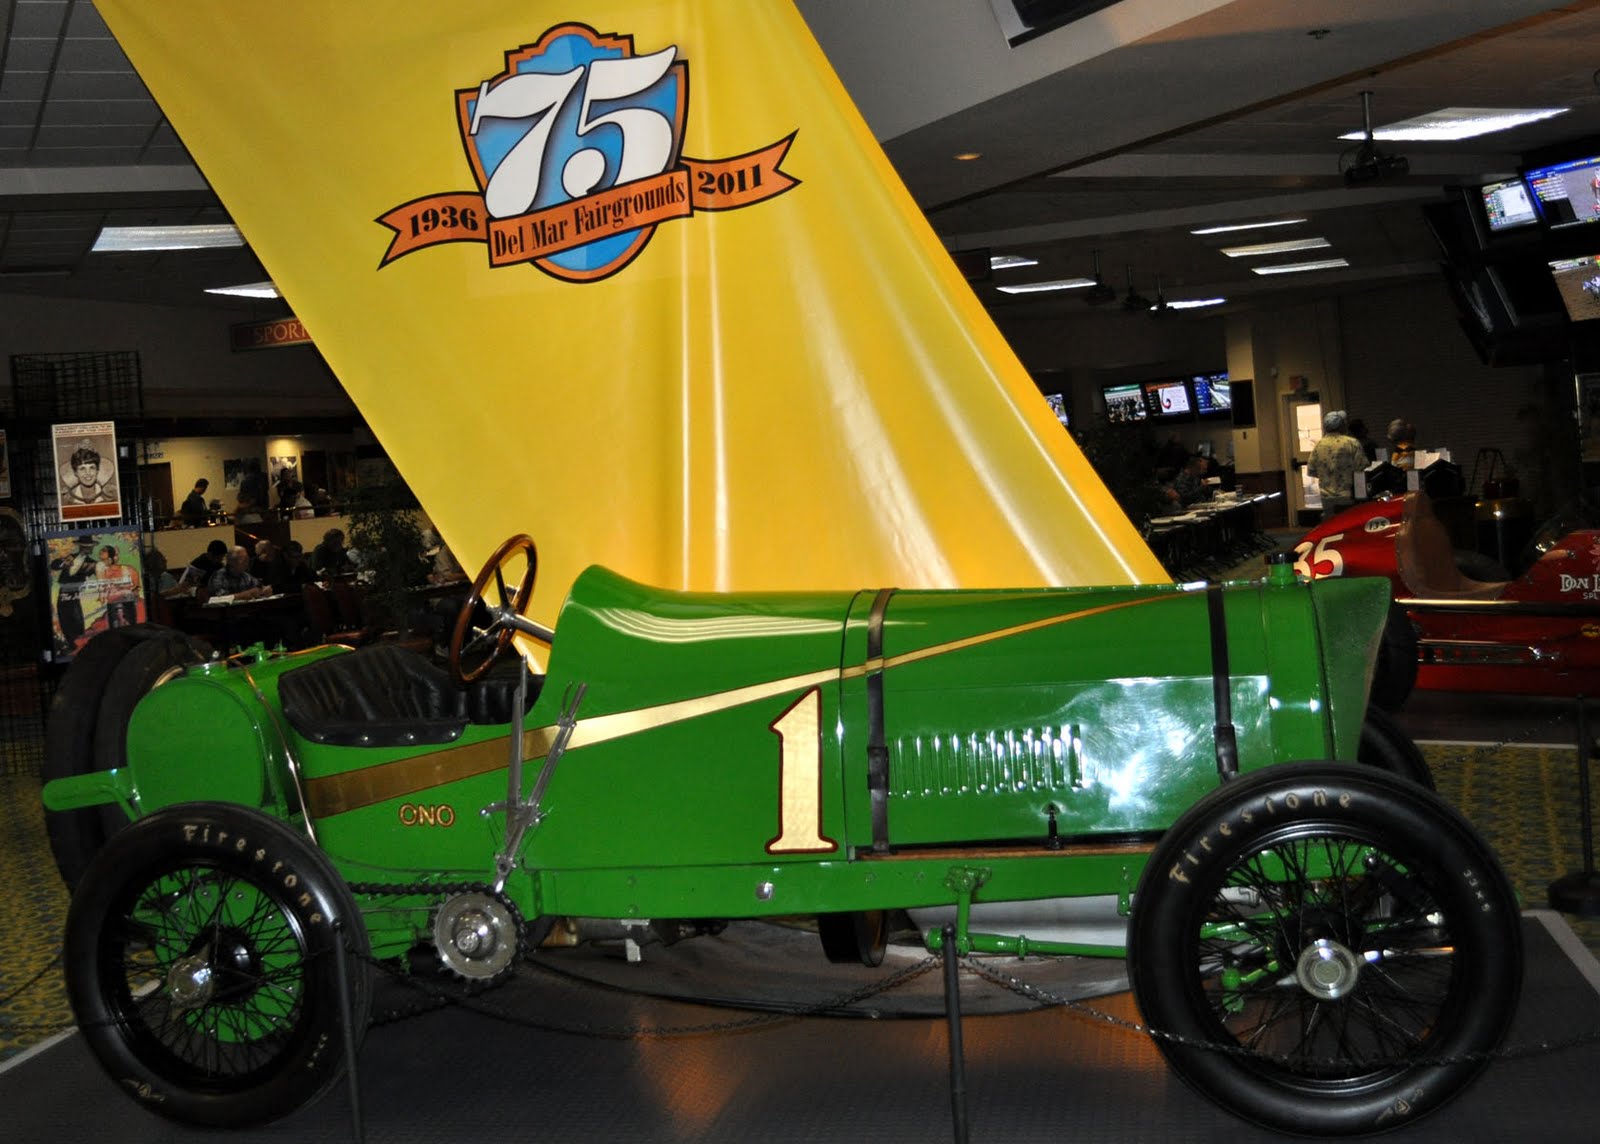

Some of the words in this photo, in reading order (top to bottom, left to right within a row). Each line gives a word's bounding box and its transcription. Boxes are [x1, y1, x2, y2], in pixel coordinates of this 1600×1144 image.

[469, 45, 678, 219] 75
[408, 204, 479, 239] 1936
[493, 226, 525, 257] Del
[530, 217, 569, 250] Mar
[573, 176, 687, 236] Fairgrounds
[697, 163, 763, 195] 2011
[765, 685, 838, 855] 1
[399, 803, 456, 827] ONO
[1168, 789, 1352, 885] Firestone
[183, 824, 322, 924] Firestone
